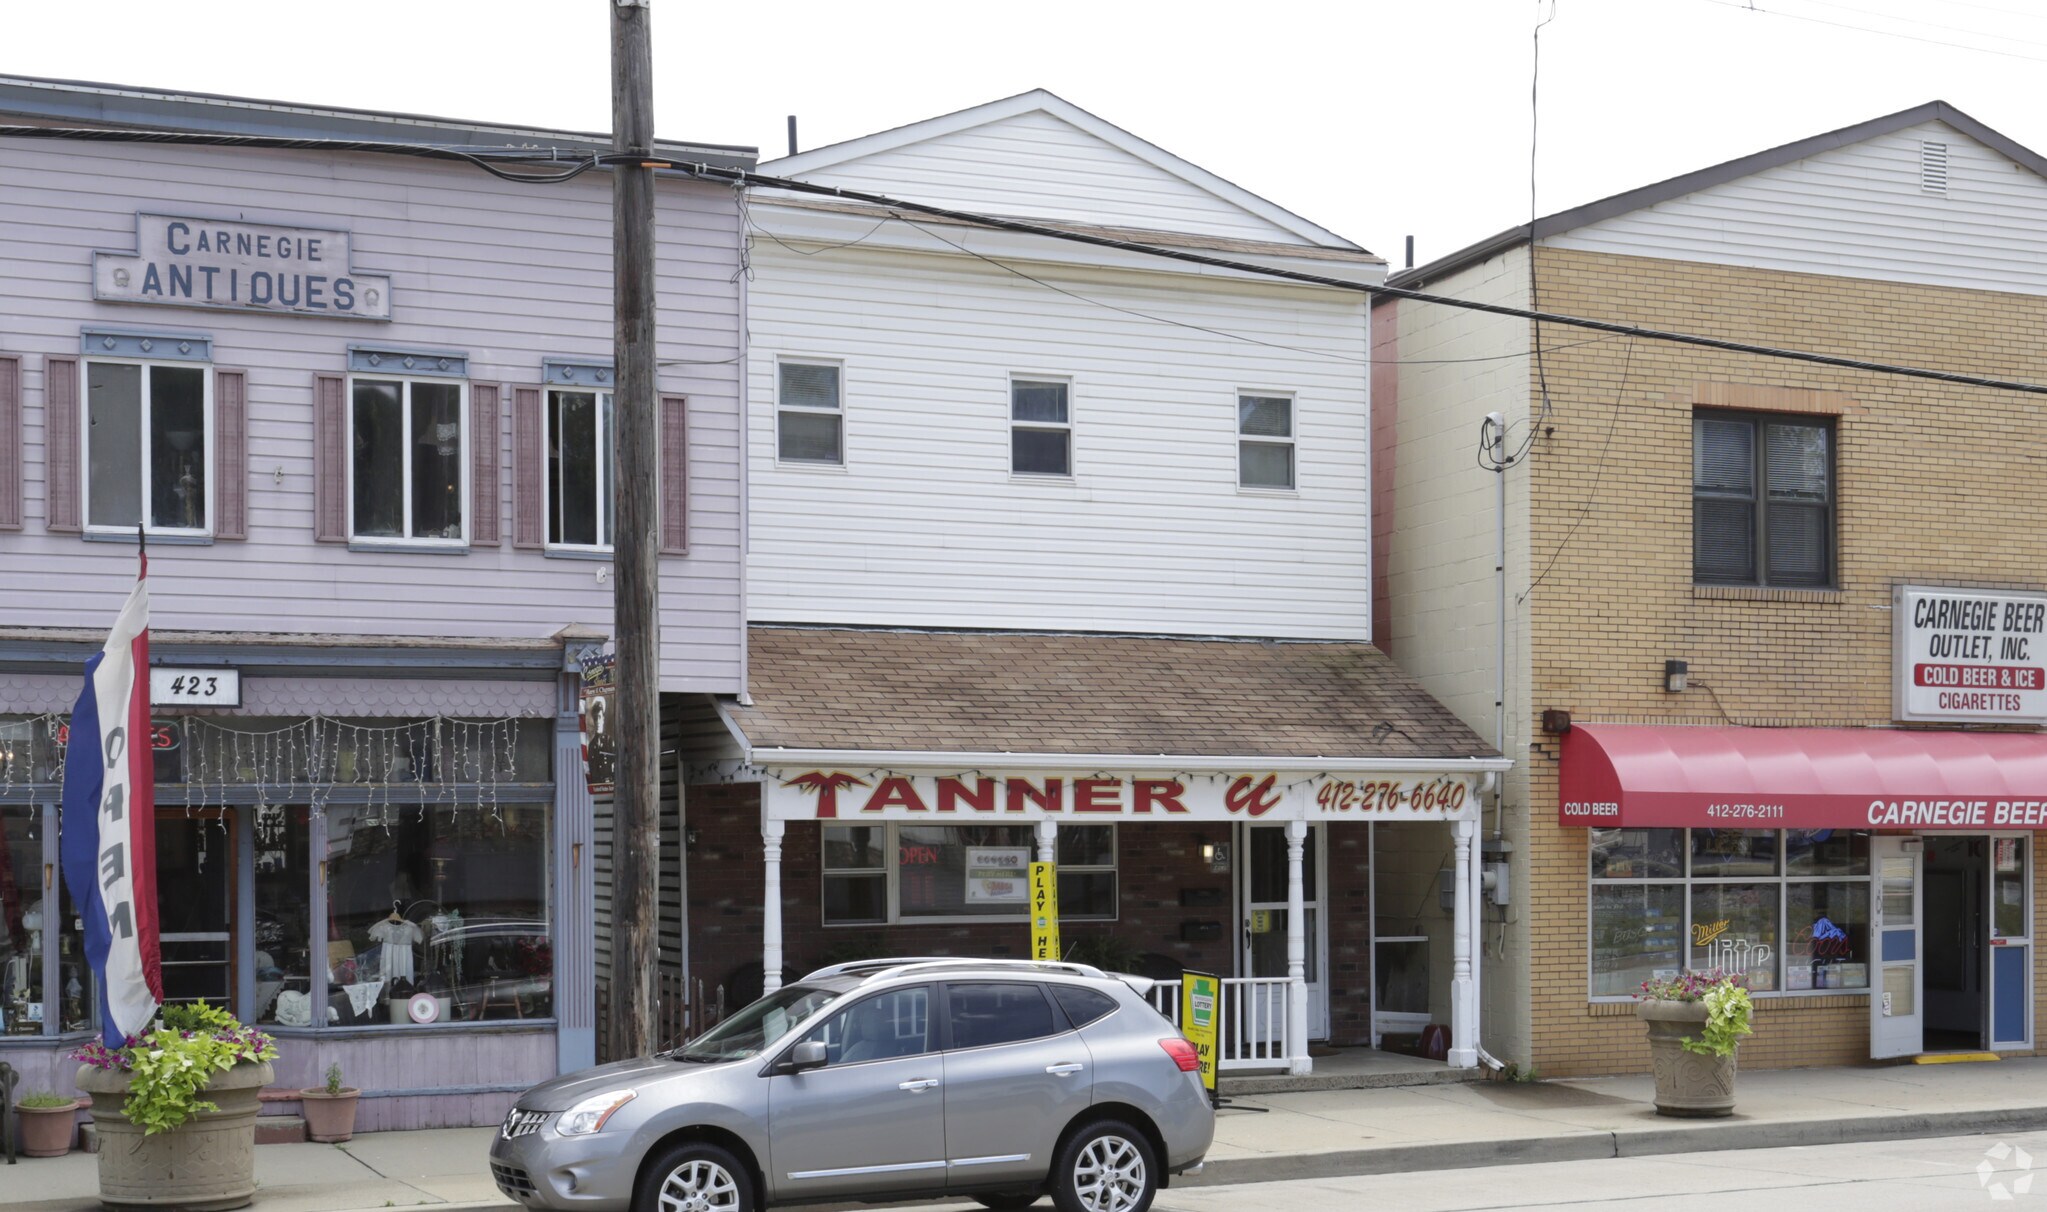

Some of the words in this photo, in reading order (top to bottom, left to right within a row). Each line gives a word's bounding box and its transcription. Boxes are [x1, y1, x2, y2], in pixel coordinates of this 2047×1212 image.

[167, 221, 323, 261] CARNEGIE
[141, 262, 355, 311] ANTIQUES
[1914, 598, 1998, 631] CARNEGIE
[2003, 602, 2045, 633] BEER
[1929, 634, 1992, 663] OUTLET,
[2000, 637, 2030, 661] INC.
[170, 675, 218, 696] 423
[1923, 666, 1959, 685] COLD
[1963, 667, 1997, 686] BEER
[2001, 669, 2011, 687] &
[2015, 670, 2036, 688] ICE
[1939, 692, 2021, 711] CIGARETTES
[780, 770, 1191, 819] TANNER
[1315, 780, 1466, 813] 412-276-6640
[1564, 802, 1590, 815] COLD
[1592, 802, 1618, 816] BEER
[1707, 804, 1784, 818] 412-276-2111
[1867, 800, 1988, 825] CARNEGIE
[899, 847, 937, 865] OPEN
[1035, 865, 1046, 912] PLAY
[1690, 919, 1730, 942] Miller
[1194, 1001, 1212, 1010] LOTTERY
[1193, 1042, 1210, 1056] LAY
[1199, 1061, 1211, 1074] RE!
